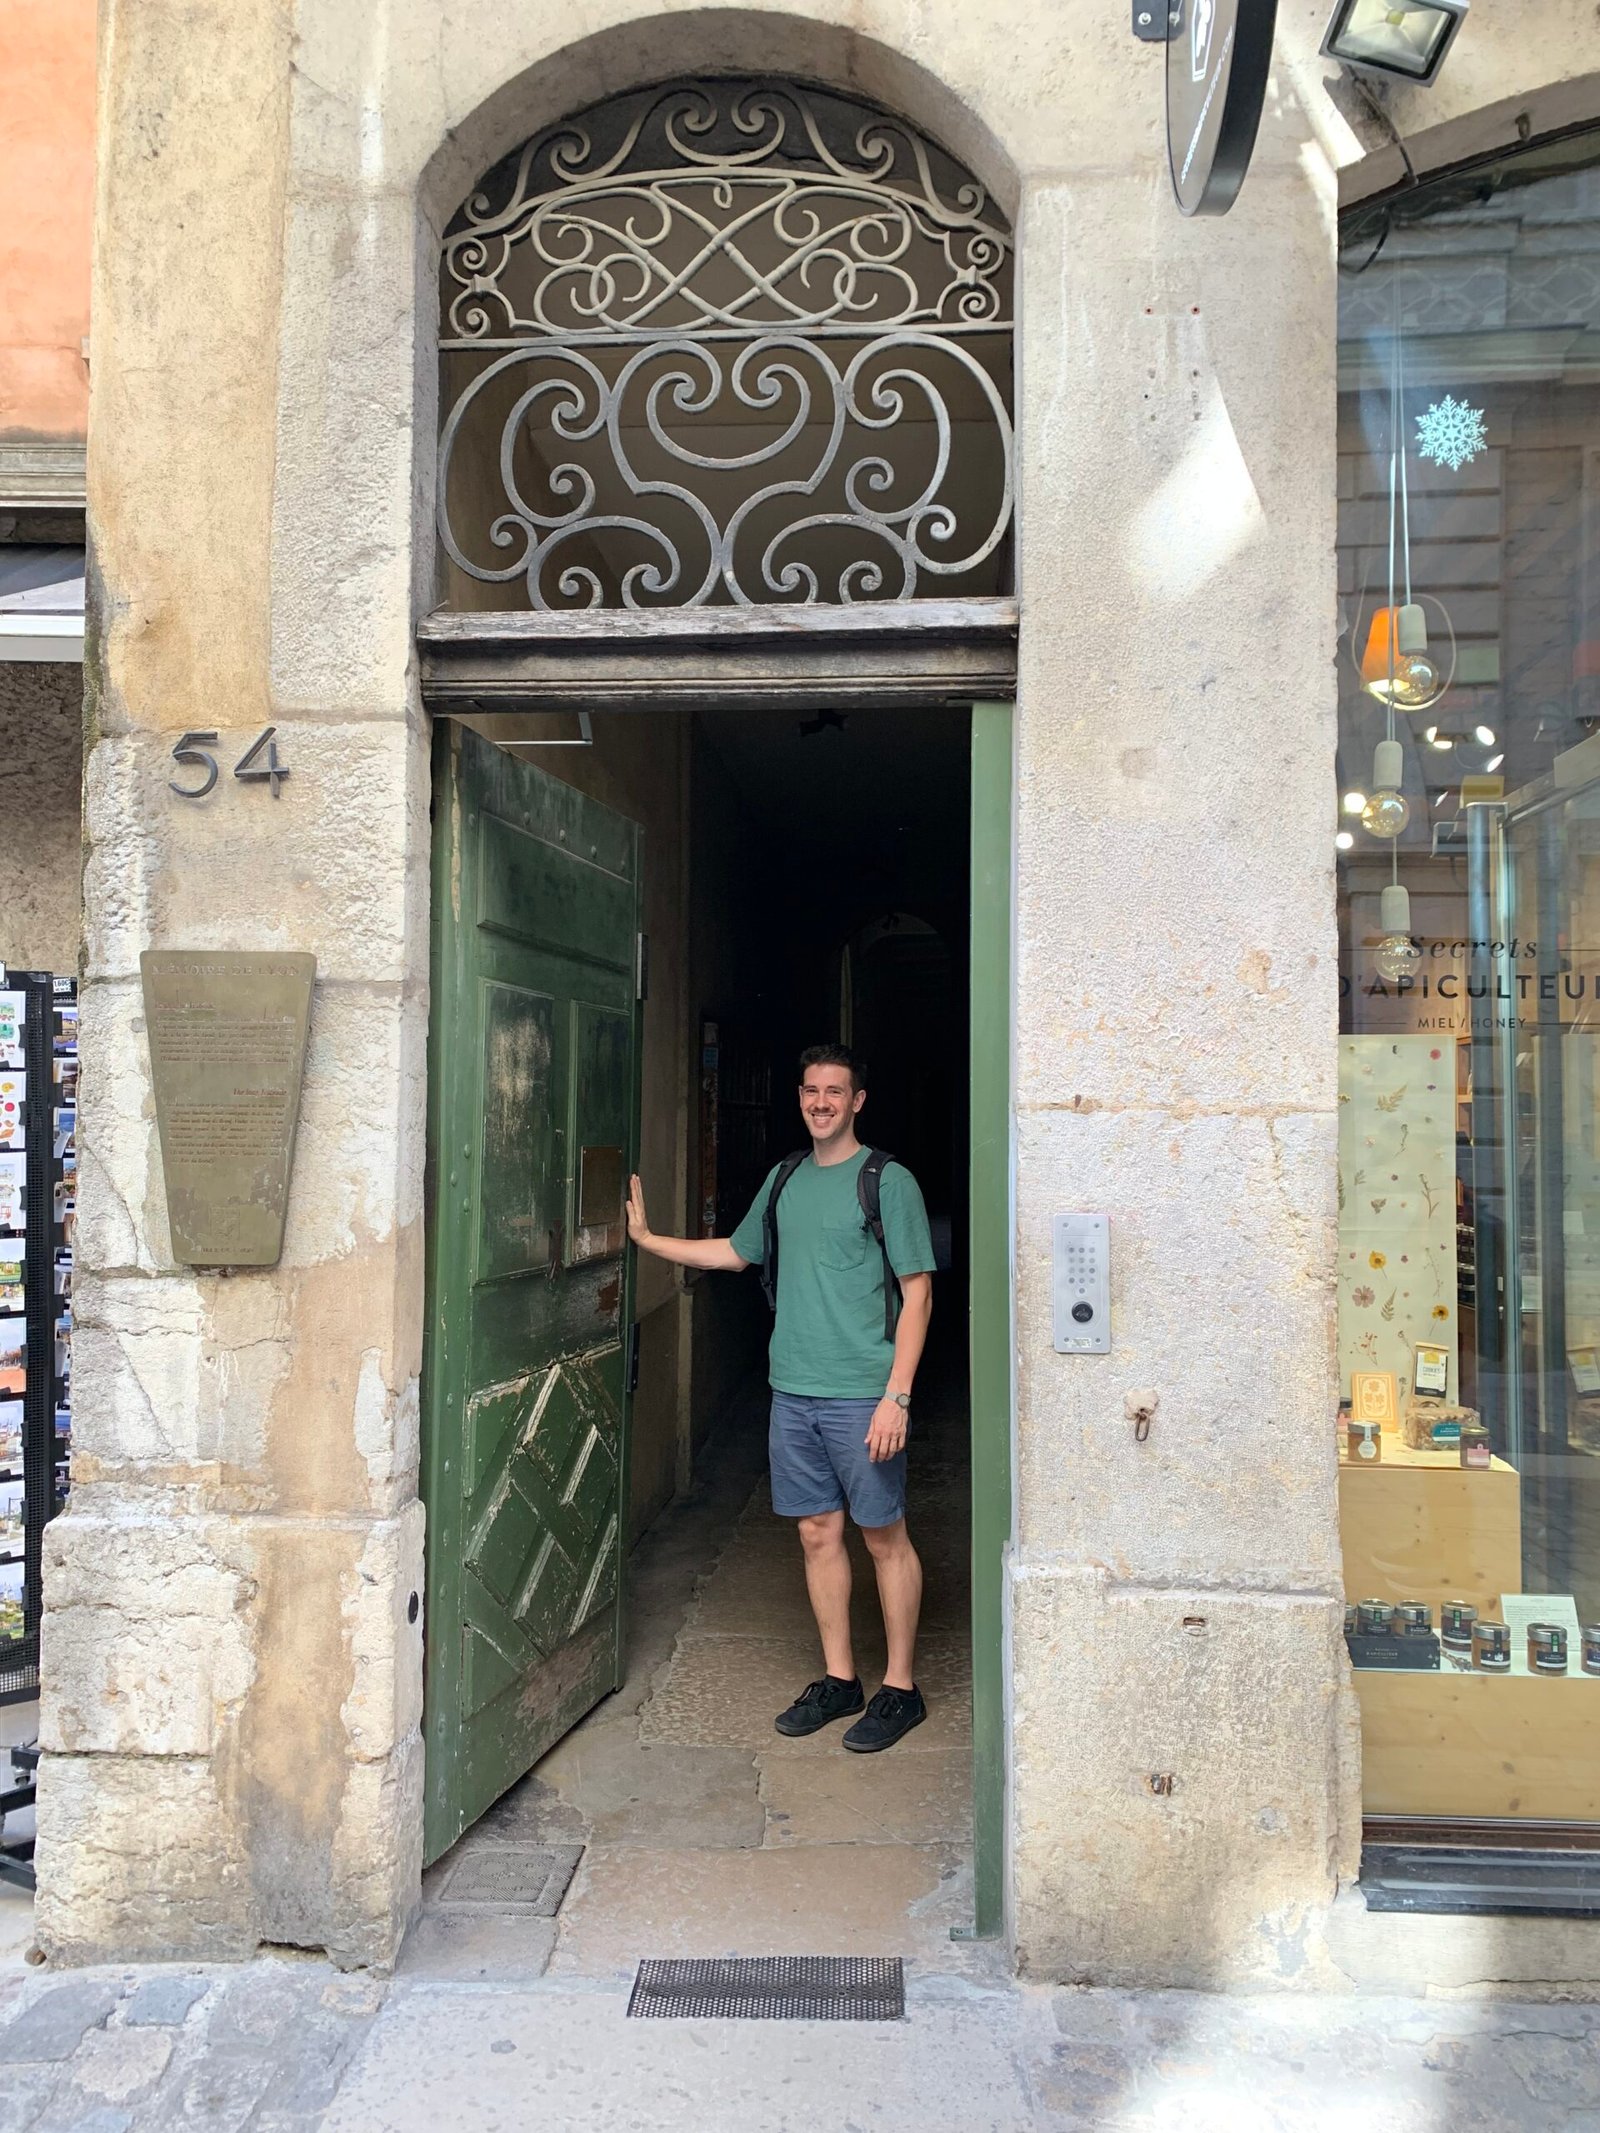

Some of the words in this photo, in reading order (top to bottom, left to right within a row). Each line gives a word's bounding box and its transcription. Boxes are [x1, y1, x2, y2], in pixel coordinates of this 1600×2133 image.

[168, 727, 290, 799] 54
[1407, 934, 1537, 959] Secrets
[1339, 974, 1600, 999] D'APICULTEU
[1417, 1018, 1455, 1028] MIEL
[1471, 1018, 1526, 1028] HONEY
